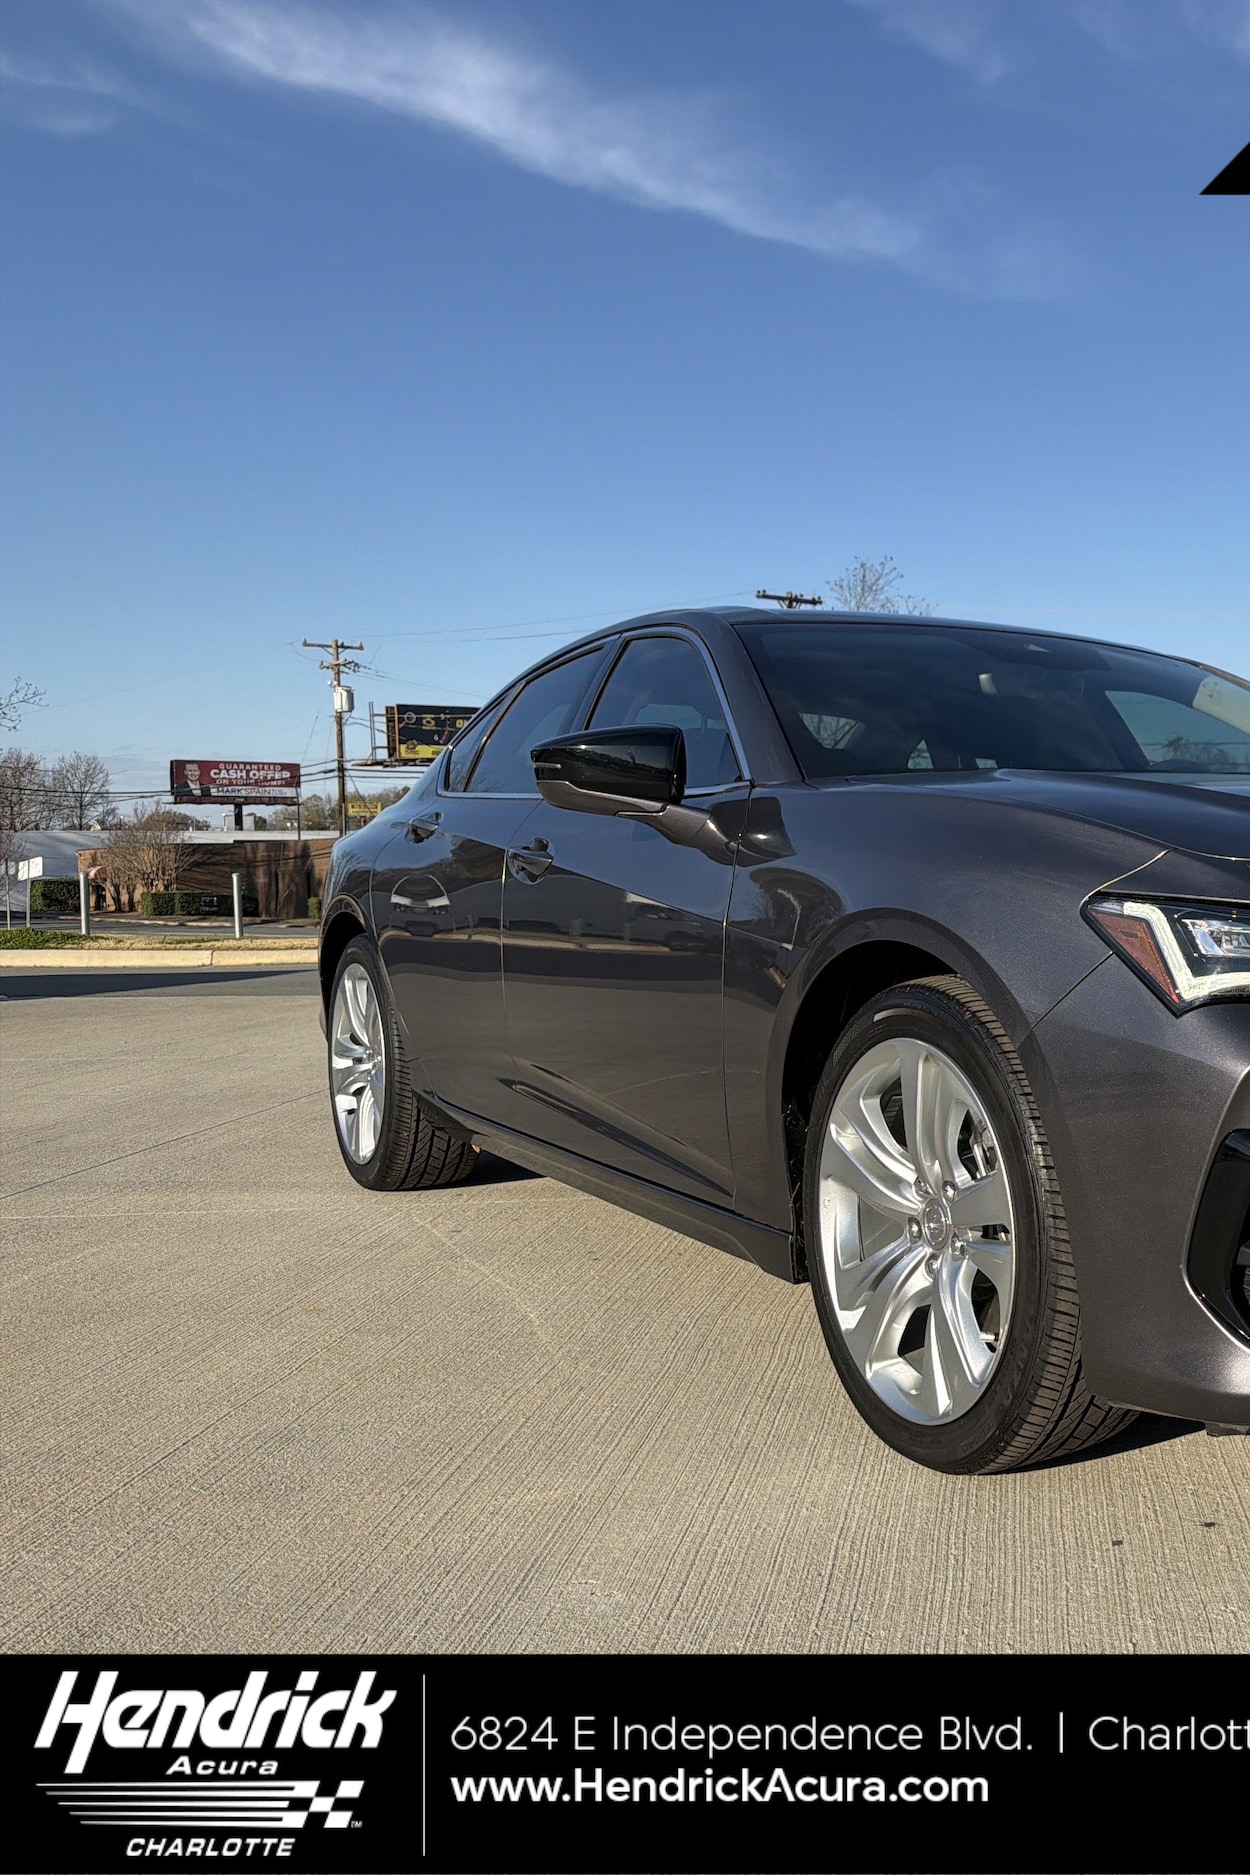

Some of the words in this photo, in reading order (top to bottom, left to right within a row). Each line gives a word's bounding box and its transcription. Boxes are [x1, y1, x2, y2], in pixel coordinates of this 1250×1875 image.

[219, 763, 282, 771] GUARANTEED
[209, 769, 247, 779] CASH
[249, 770, 291, 780] OFFER
[217, 788, 243, 796] MARK
[244, 788, 271, 797] SPAIN
